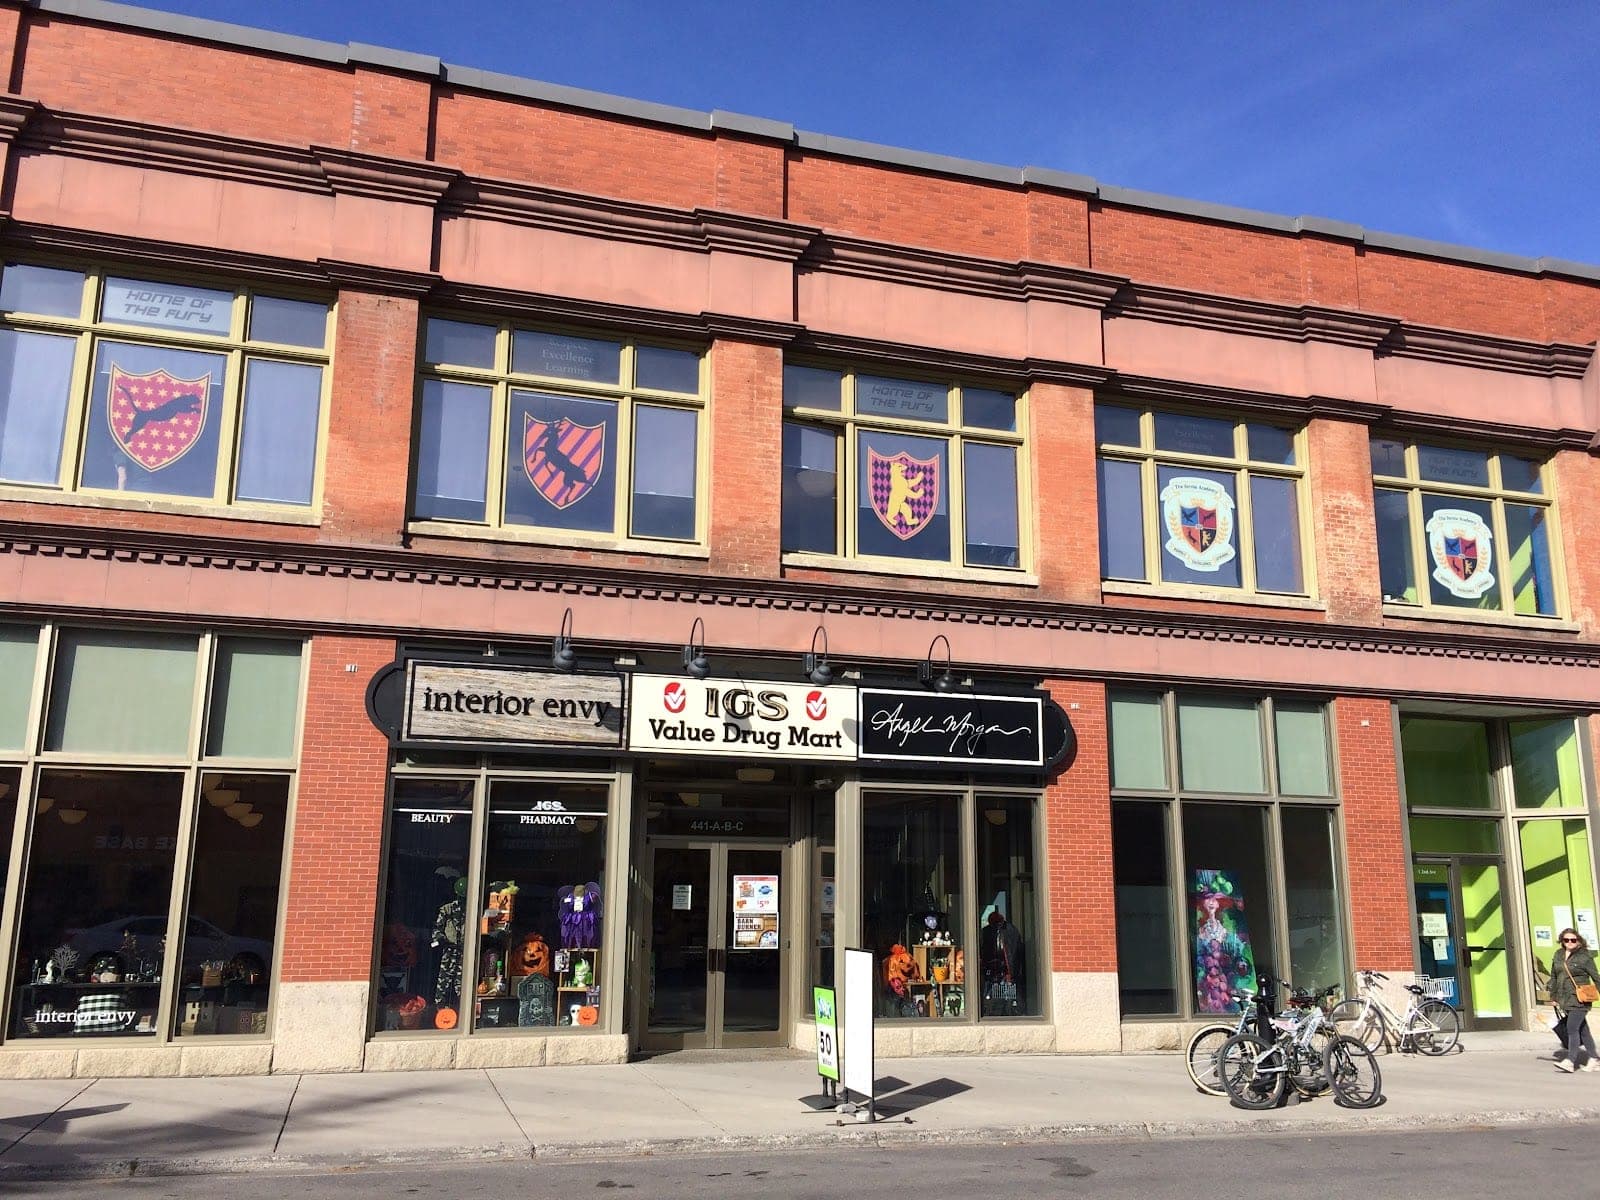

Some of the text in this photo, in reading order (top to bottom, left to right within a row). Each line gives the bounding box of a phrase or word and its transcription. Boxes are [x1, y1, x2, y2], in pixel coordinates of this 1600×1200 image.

[190, 298, 213, 309] OF
[423, 686, 613, 728] interior envy
[705, 687, 789, 722] IGS
[649, 718, 842, 750] Value Drug Mart
[411, 813, 454, 823] BEAUTY
[519, 815, 577, 825] PHARMACY
[690, 820, 744, 832] 441-A-B-C
[35, 1009, 136, 1025] interior envy
[819, 1030, 832, 1056] 50
